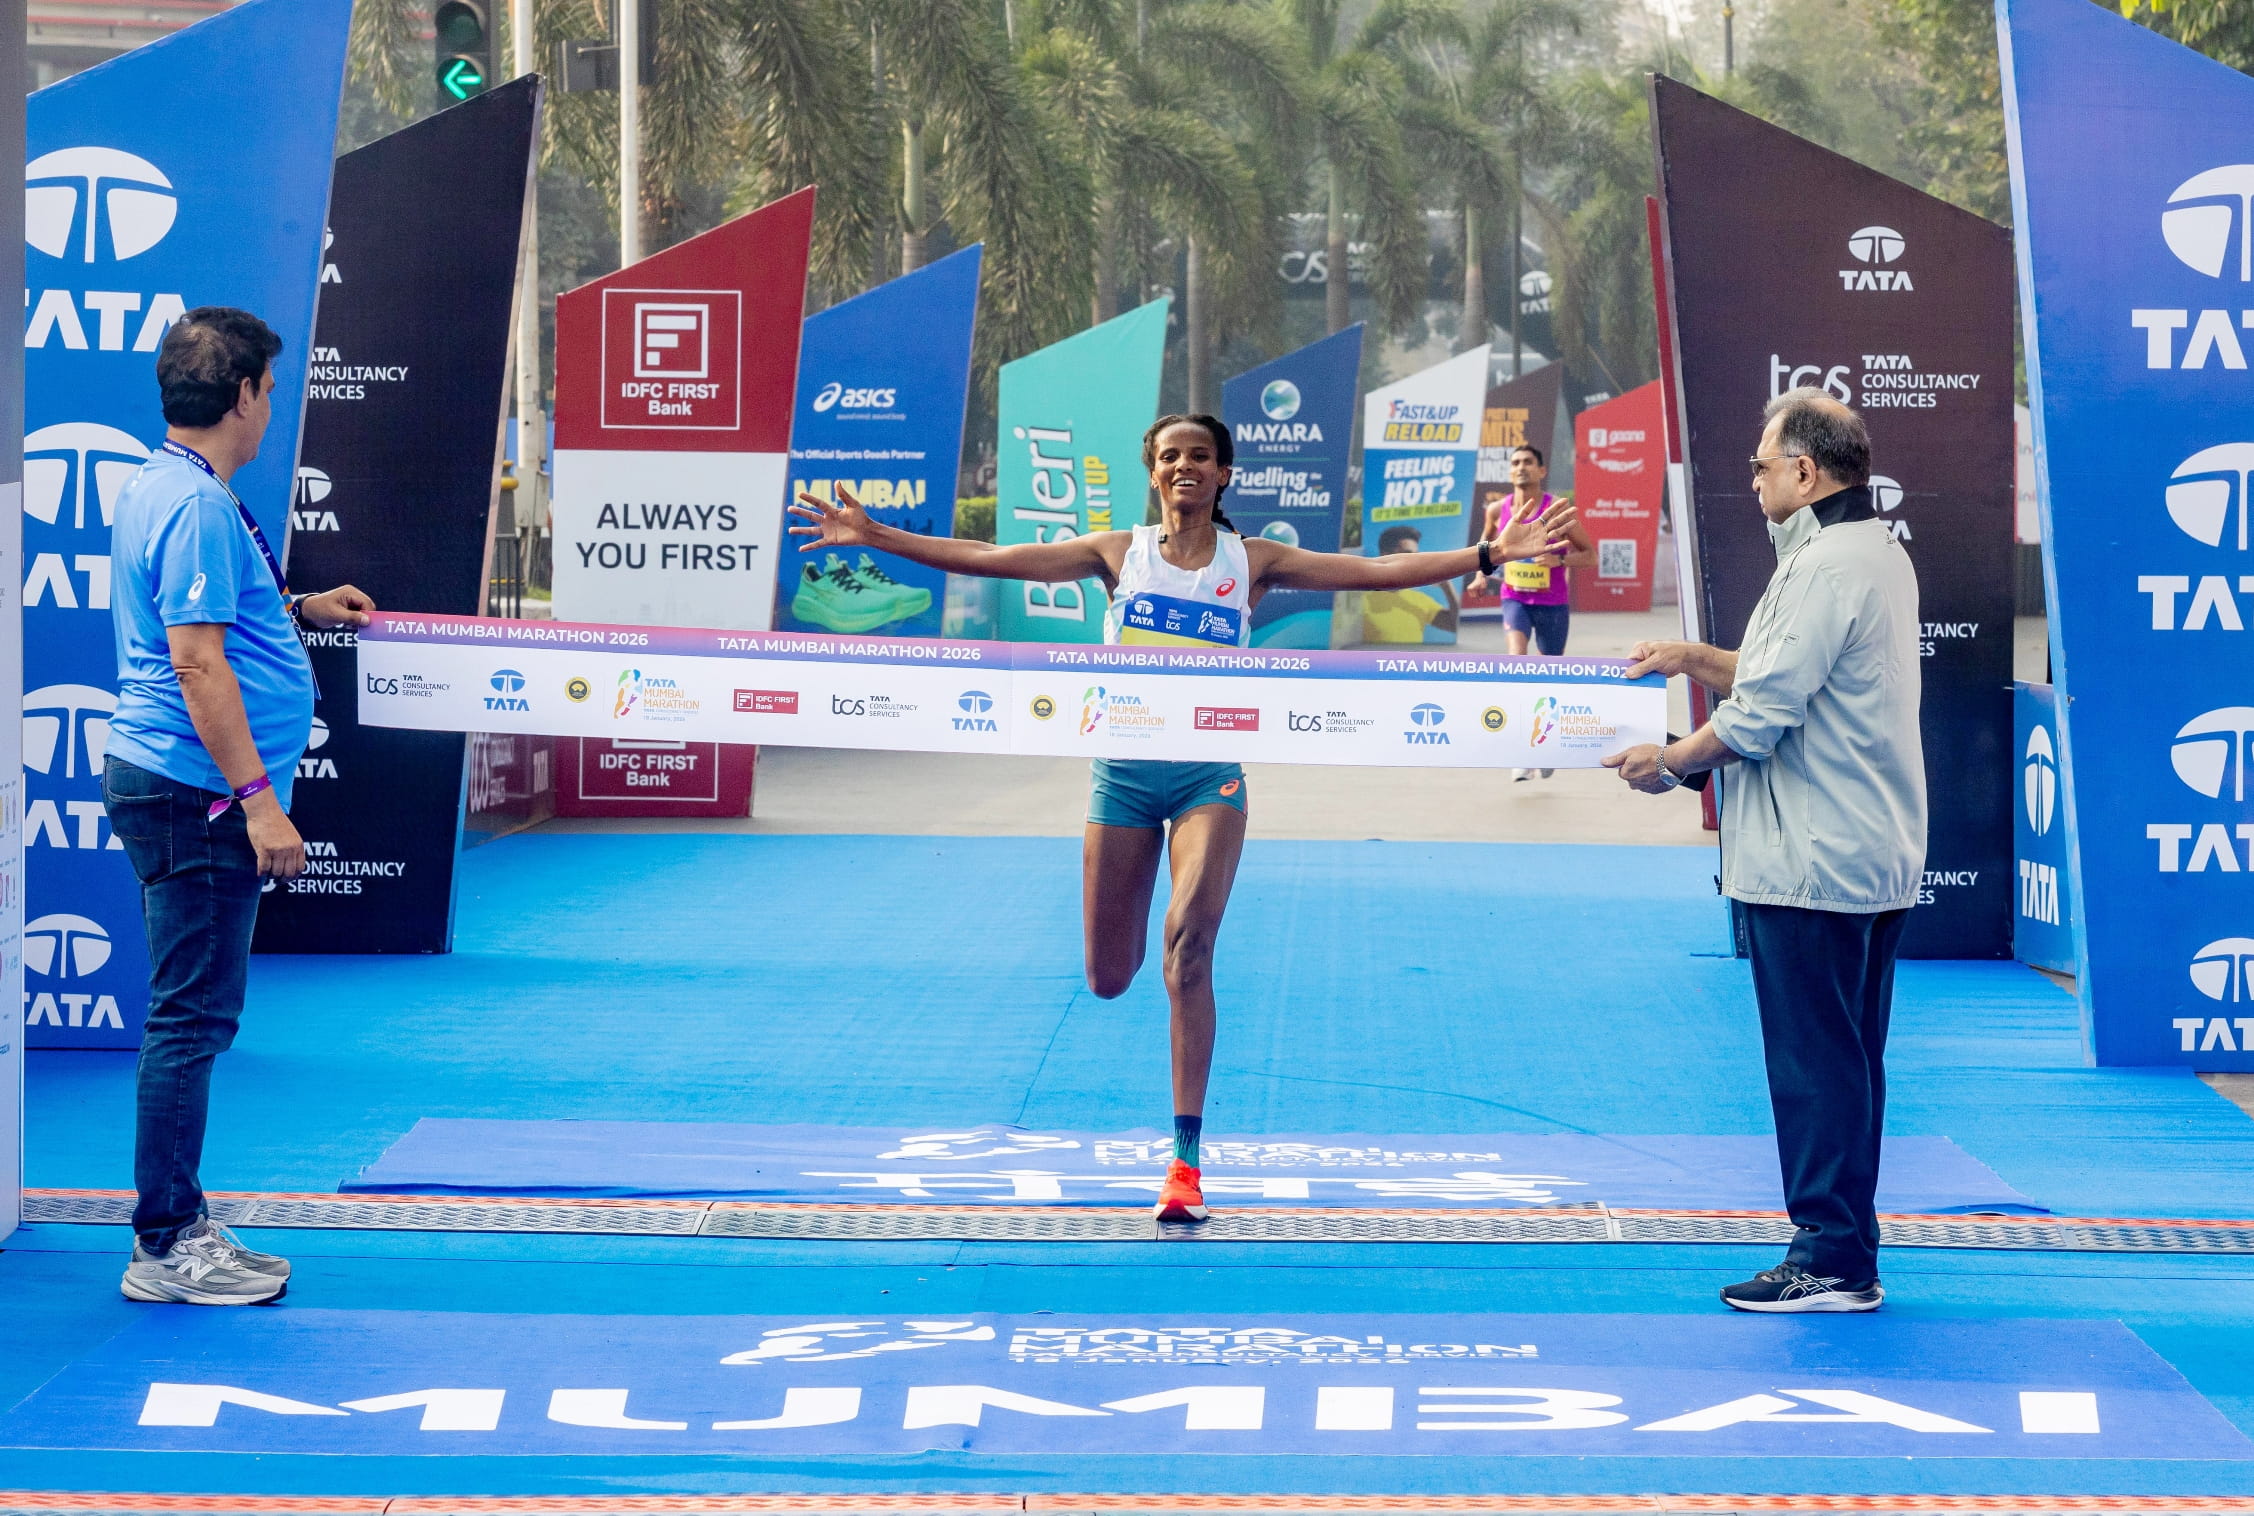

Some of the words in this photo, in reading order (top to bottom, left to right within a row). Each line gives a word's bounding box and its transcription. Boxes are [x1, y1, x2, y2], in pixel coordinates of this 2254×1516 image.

[1839, 270, 1914, 291] TATA
[24, 288, 187, 353] ATA
[1862, 355, 1913, 370] TATA
[309, 366, 408, 382] NSULTANCY
[1770, 354, 1851, 406] tcs
[1861, 373, 1981, 390] CONSULTANCY
[307, 384, 366, 400] RVICES
[621, 383, 663, 399] IDFC
[668, 383, 720, 400] FIRST
[648, 400, 693, 416] Bank
[1861, 393, 1937, 408] SERVICES
[1236, 423, 1323, 442] NAYARA
[1385, 423, 1461, 441] RELOAD
[1258, 444, 1301, 453] ENERGY
[1384, 455, 1455, 480] FEELING
[1229, 467, 1308, 491] Fuelling
[1279, 487, 1331, 507] India
[1382, 475, 1456, 508] HOT?
[293, 511, 341, 532] ATA
[596, 503, 738, 532] ALWAYS
[1013, 426, 1087, 622] Bsleri
[576, 542, 647, 569] YOU
[662, 543, 759, 571] FIRST
[1129, 615, 1155, 627] TATA
[1165, 620, 1180, 631] tcs
[300, 631, 359, 647] ERVICES
[385, 620, 427, 635] TATA
[432, 623, 502, 639] MUMBAI
[507, 627, 605, 644] MARATHON
[609, 632, 649, 646] 2026
[717, 637, 759, 651] TATA
[764, 639, 834, 655] MUMBAI
[840, 643, 937, 659] MARATHON
[942, 646, 982, 661] 2026
[1047, 650, 1089, 665] TATA
[1093, 652, 1164, 668] MUMBAI
[1169, 654, 1266, 670] MARATHON
[1271, 657, 1311, 671] 2026
[1376, 659, 1418, 673] TATA
[1423, 660, 1494, 675] MUMBAI
[1499, 662, 1597, 677] MARATHON
[1600, 664, 1629, 679] 202
[367, 672, 398, 695] tcs
[403, 674, 423, 682] TATA
[644, 678, 677, 688] TATA
[402, 682, 451, 692] CONSULTANCY
[402, 690, 433, 698] SERVICES
[644, 687, 685, 699] MUMBAI
[483, 697, 530, 711] TATA
[644, 699, 700, 710] MARATHON
[755, 695, 772, 703] IDFC
[774, 696, 796, 704] FIRST
[755, 703, 774, 711] Bank
[832, 694, 865, 716] tcs
[869, 703, 918, 711] CONSULTANCY
[1110, 696, 1142, 705] TATA
[869, 710, 900, 718] SERVICES
[1109, 705, 1150, 716] MUMBAI
[1561, 705, 1592, 714] TATA
[952, 717, 998, 732] TATA
[1109, 716, 1165, 727] MARATHON
[1217, 720, 1235, 728] Bank
[1289, 710, 1322, 732] tcs
[1560, 715, 1601, 726] MUMBAI
[1404, 731, 1451, 745] TATA
[1560, 726, 1617, 736] MARATHON
[600, 754, 641, 769] IDFC
[646, 755, 698, 770] FIRST
[626, 772, 670, 787] Bank
[304, 842, 338, 857] ATA
[302, 861, 406, 877] ONSULTANCY
[287, 879, 362, 894] SERVICES
[2019, 859, 2060, 926] TATA
[24, 992, 125, 1030] ATA
[2172, 1018, 2254, 1052] TAT
[1015, 1327, 1312, 1336] TATA
[1011, 1335, 1384, 1345] MUMBAI
[1009, 1343, 1538, 1354] MARATHON
[137, 1382, 2103, 1436] MUMBAI
